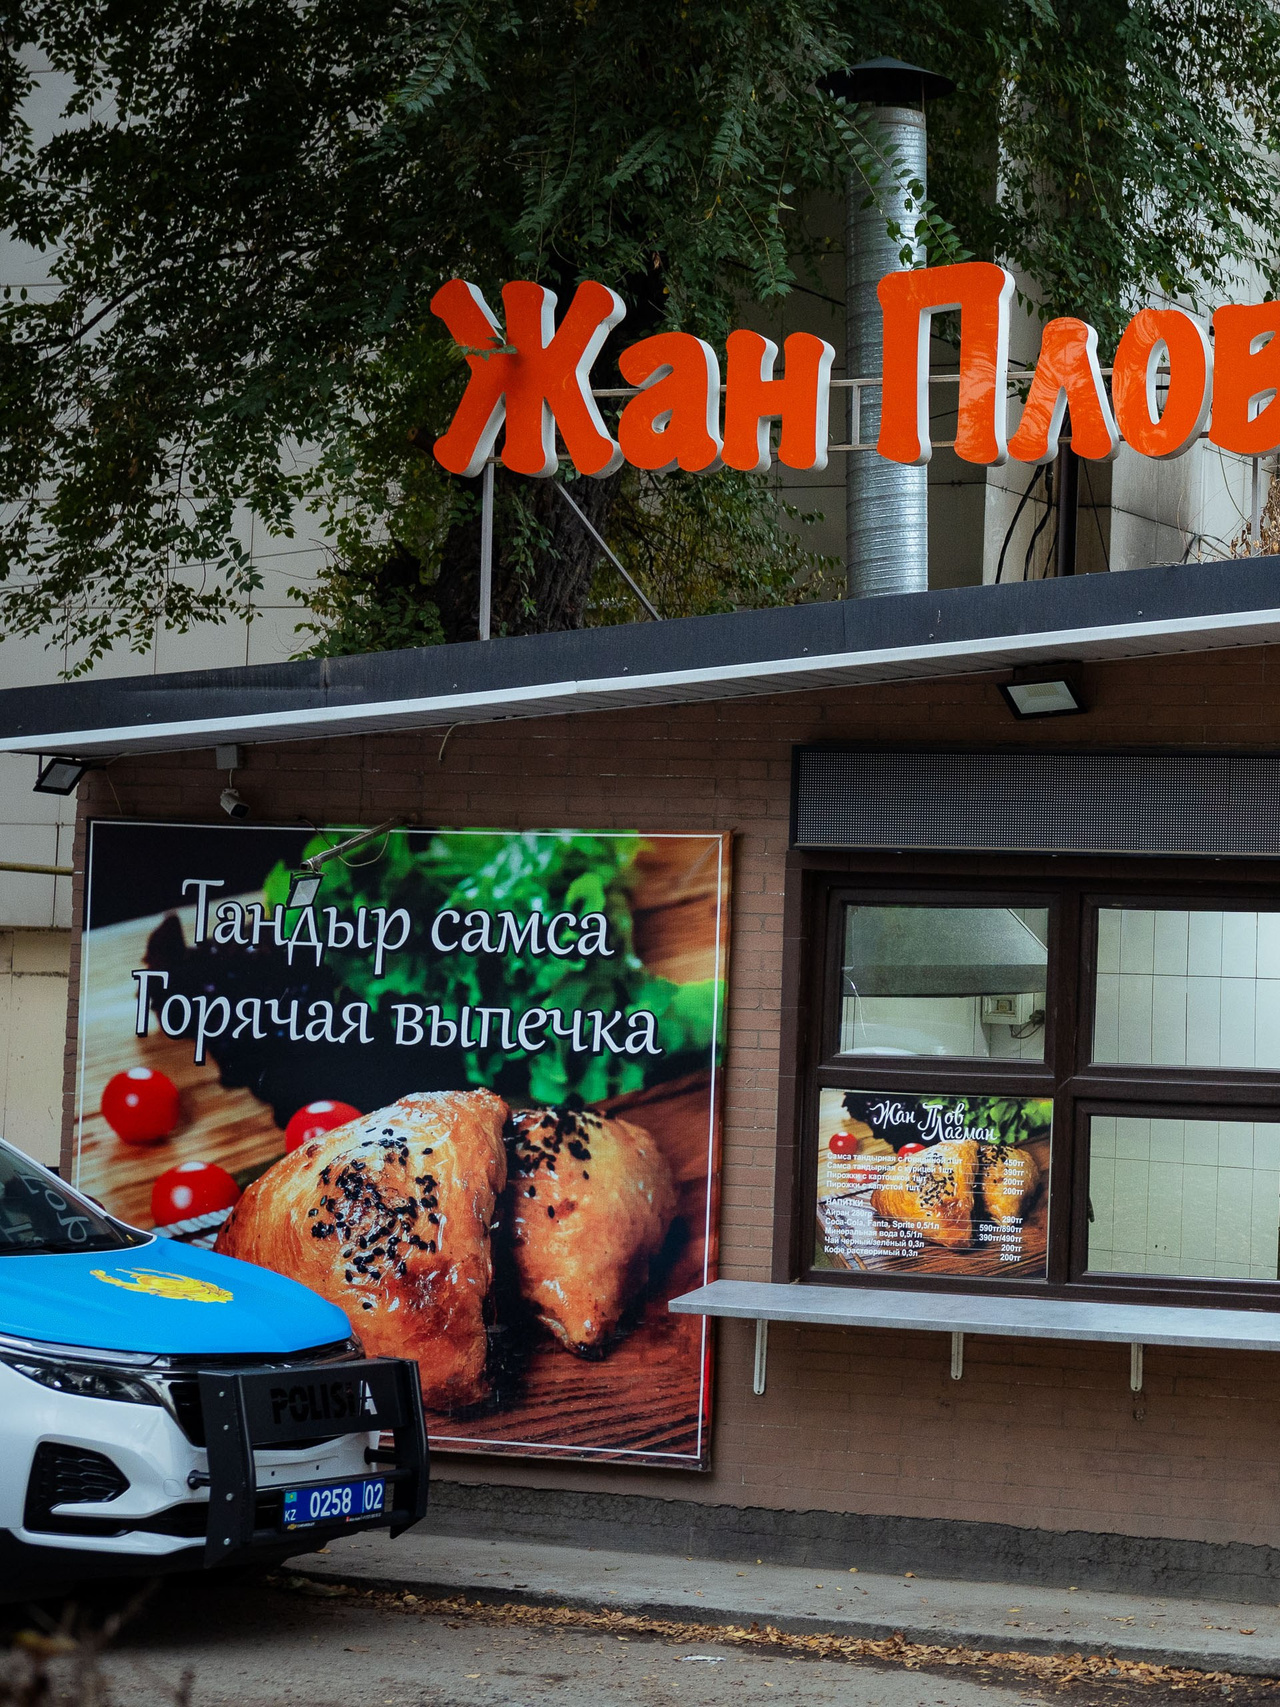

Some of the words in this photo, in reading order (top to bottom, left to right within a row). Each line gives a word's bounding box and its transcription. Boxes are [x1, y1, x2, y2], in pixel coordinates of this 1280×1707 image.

[430, 278, 836, 478] Жан
[181, 878, 411, 979] Тандыр
[431, 907, 615, 956] самса
[132, 970, 374, 1064] Горячая
[390, 1002, 663, 1055] выпечка
[869, 1100, 916, 1129] Жан
[921, 1115, 998, 1144] Лагман
[827, 1152, 852, 1161] Самса
[852, 1154, 896, 1164] тандырная
[1003, 1158, 1025, 1167] 450тг
[826, 1161, 852, 1170] Самса
[852, 1163, 897, 1173] тандырная
[1003, 1168, 1025, 1176] 390тг
[826, 1170, 861, 1180] Пирожки
[1003, 1178, 1025, 1186] 200тг
[826, 1180, 861, 1189] Пирожки
[1003, 1187, 1024, 1196] 200тг
[826, 1198, 864, 1207] НАПИТКИ
[825, 1208, 850, 1218] Айран
[867, 1219, 891, 1229] Fanta,
[892, 1220, 915, 1230] Sprite
[825, 1226, 878, 1237] Минеральная
[879, 1230, 898, 1239] вода
[899, 1230, 923, 1239] 0,5/1л
[979, 1233, 1023, 1243] 390тг/490тг
[824, 1236, 840, 1245] Чай
[908, 1239, 925, 1249] 0,3л
[1001, 1244, 1022, 1253] 200тг
[824, 1245, 845, 1255] Кофе
[846, 1247, 900, 1257] растворимый
[901, 1248, 919, 1258] 0,3л
[1000, 1253, 1022, 1262] 200тг
[309, 1487, 352, 1519] 0258
[364, 1482, 384, 1510] 02
[284, 1509, 297, 1522] KZ
